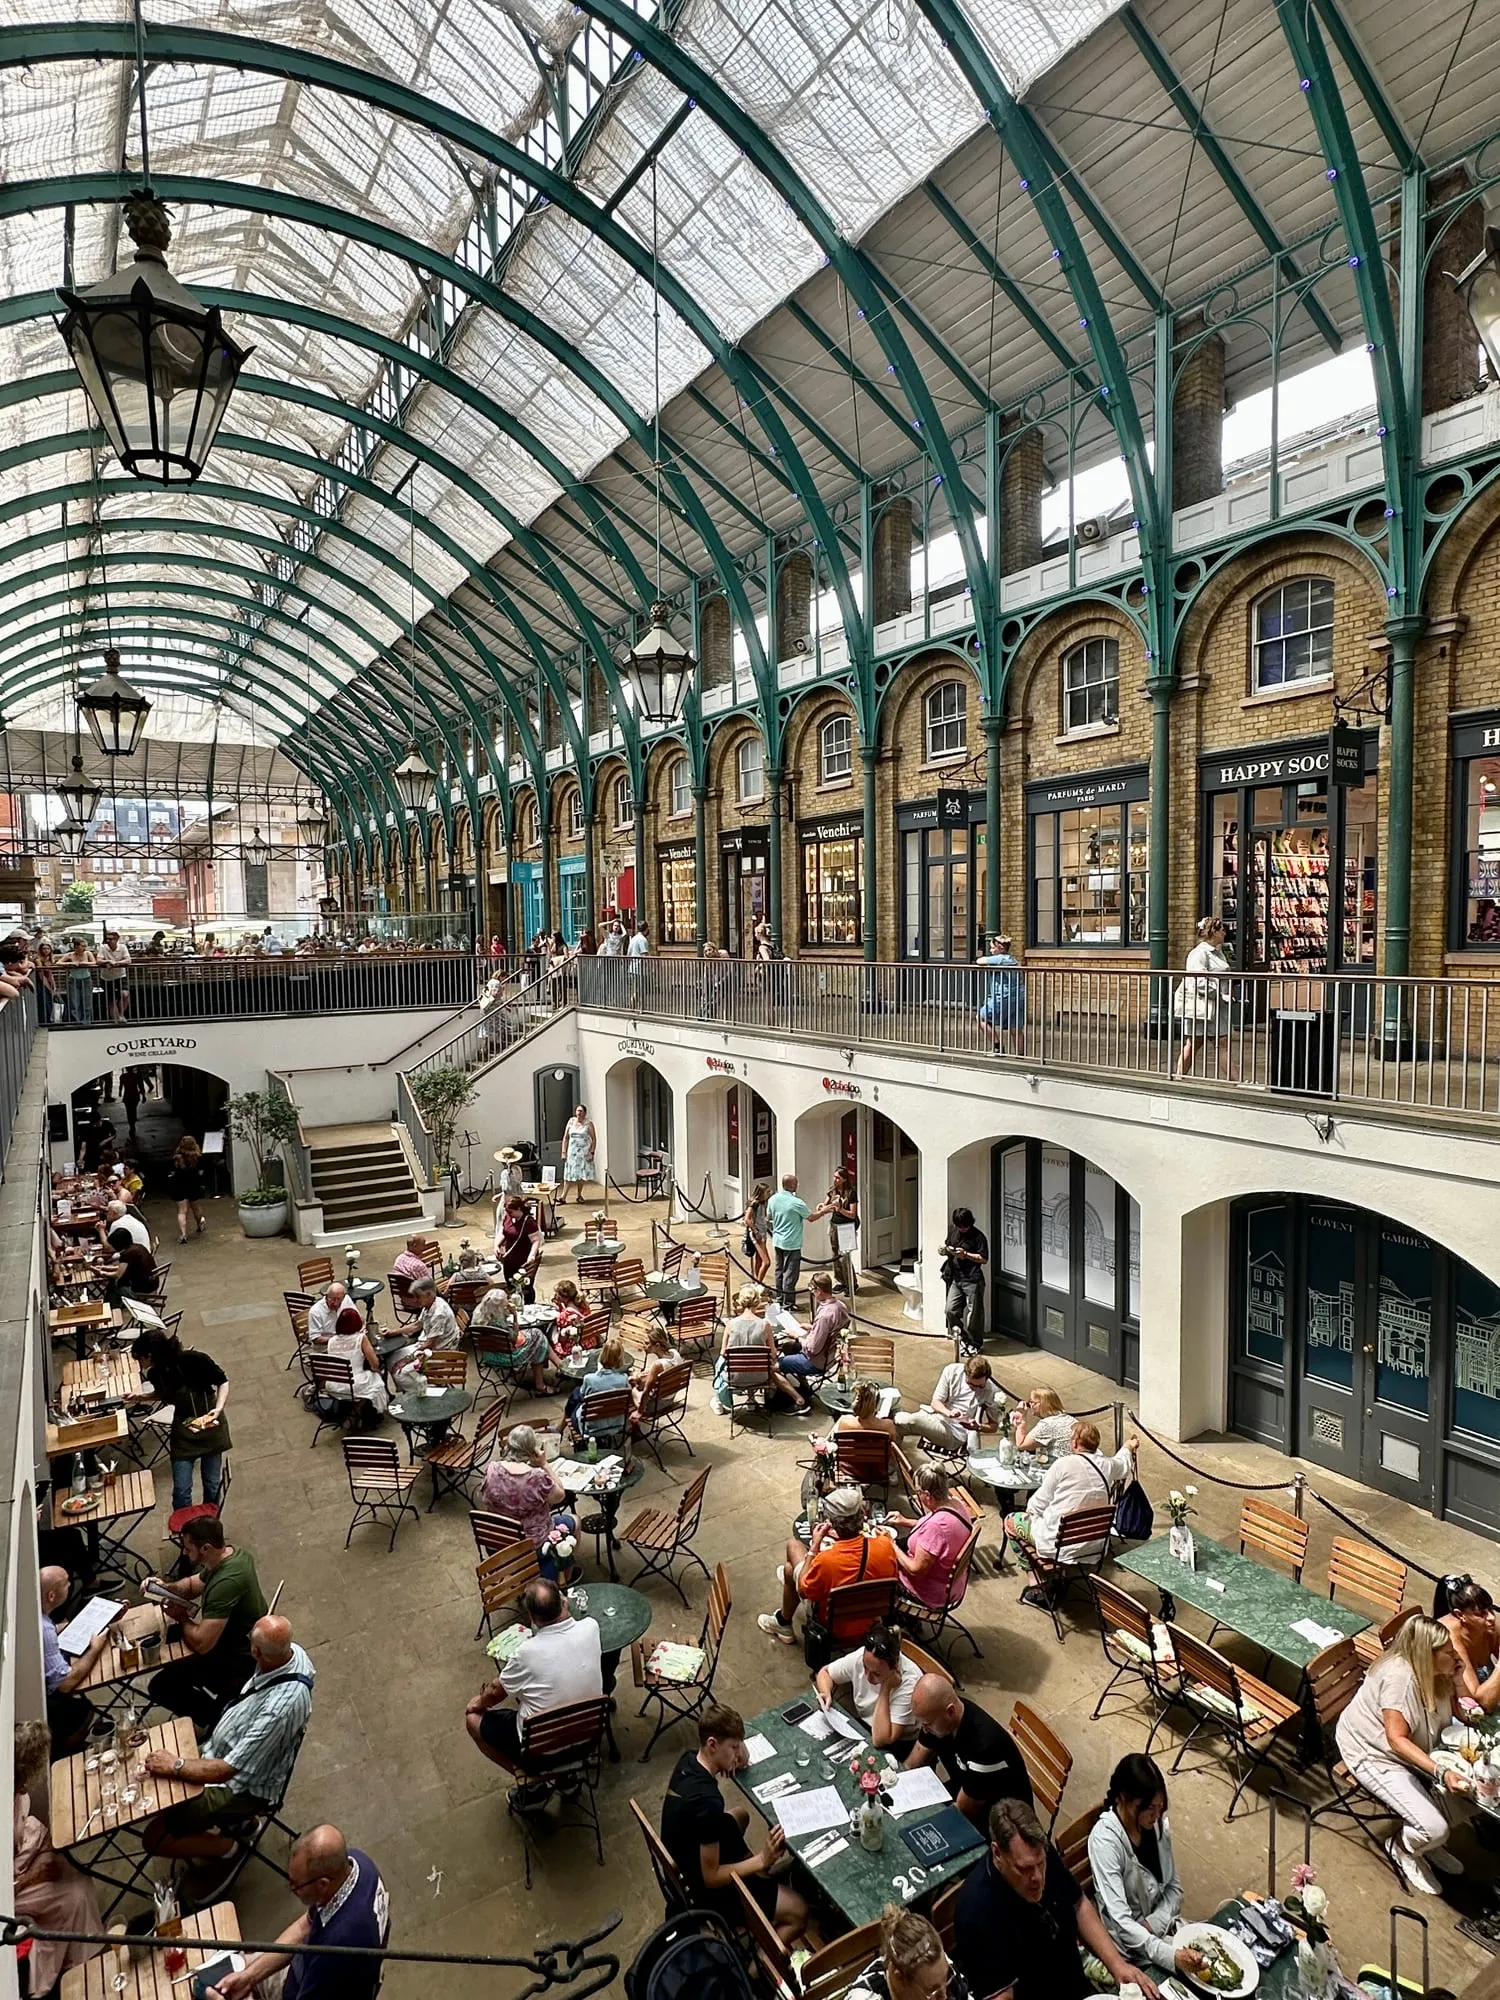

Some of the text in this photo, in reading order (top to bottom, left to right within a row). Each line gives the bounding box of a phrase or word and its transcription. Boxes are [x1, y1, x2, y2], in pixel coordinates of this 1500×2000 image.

[1220, 753, 1330, 783] HAPPY SOC
[1336, 758, 1359, 769] SOCKS
[1047, 788, 1083, 801] PARFUMS
[1097, 782, 1127, 793] MARLY
[1076, 794, 1095, 803] PARIS
[912, 810, 937, 820] PARFUM
[817, 822, 850, 839] Venchi
[669, 846, 691, 859] Venchi
[106, 1037, 197, 1056] COURTYARD
[617, 1039, 655, 1056] COURTYARD
[1310, 1216, 1431, 1249] COVENT GARDEN
